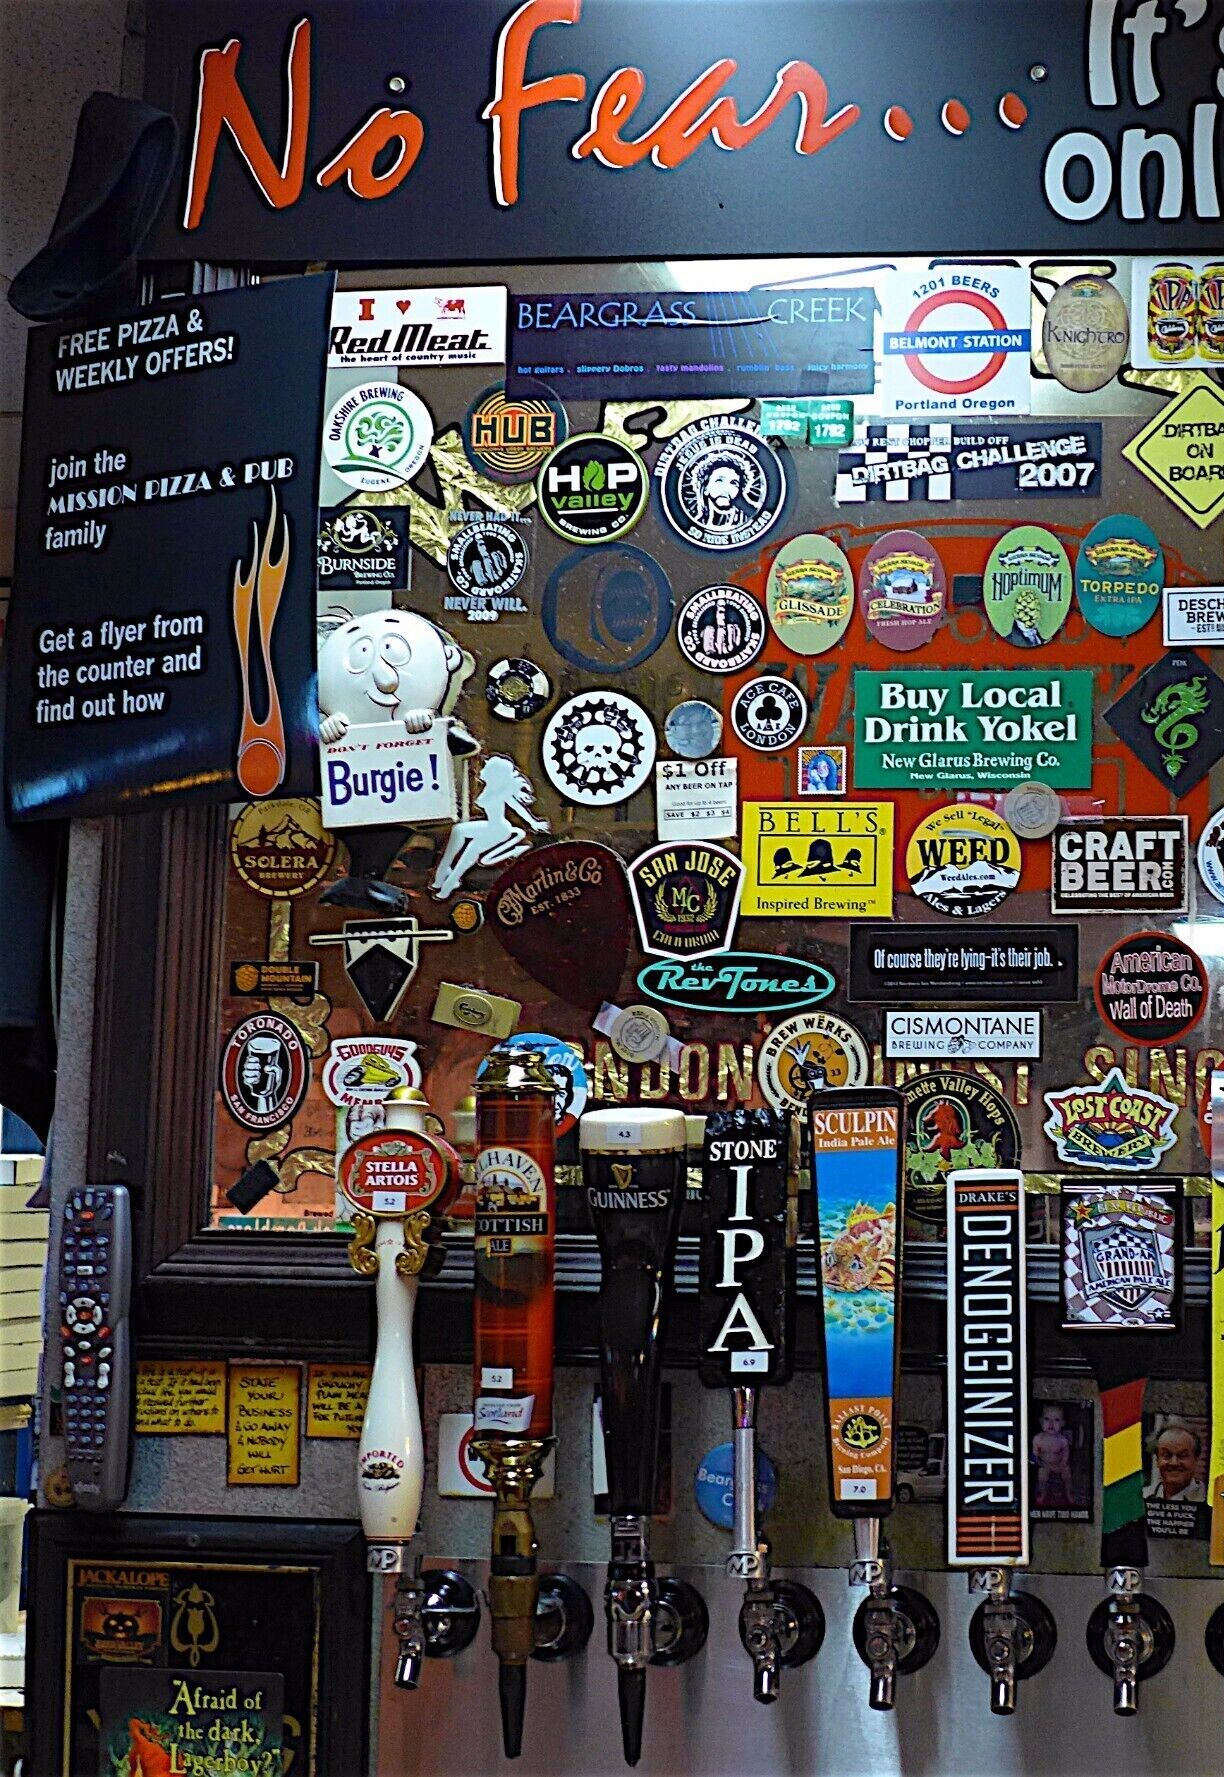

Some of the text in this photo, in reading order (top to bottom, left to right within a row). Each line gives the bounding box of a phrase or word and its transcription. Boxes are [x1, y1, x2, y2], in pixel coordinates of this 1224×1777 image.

[184, 19, 425, 230] No
[912, 275, 1000, 299] 1201 BEERS
[518, 297, 867, 329] BEARGRASS CREEK
[58, 308, 203, 358] FREE PIZZA &
[889, 334, 1022, 350] BELMONT STATION
[56, 336, 234, 392] WEEKLY OFFERS!
[895, 398, 1016, 411] Portland Oregon
[474, 414, 554, 446] HUB
[851, 435, 1087, 486] DIRTBAG CHALLENGE
[1186, 443, 1214, 459] ON
[48, 450, 126, 488] join the
[1018, 462, 1096, 488] 2007
[47, 457, 294, 515] MISSION PIZZA & PUB
[551, 493, 634, 512] valley
[45, 519, 107, 551] family
[1080, 579, 1159, 596] TORPEDO
[778, 599, 845, 618] GLISSADE
[870, 599, 941, 615] CELEBRATION
[39, 614, 203, 653] Get a flyer from
[37, 645, 201, 689] the counter and
[36, 689, 165, 724] find out how
[741, 682, 800, 709] ACE CAFE
[880, 680, 1062, 716] Buy Local
[740, 722, 796, 745] LONDON
[864, 713, 1078, 743] Drink Yokel
[662, 760, 728, 779] $1 Off
[882, 751, 1061, 771] New Glarus Brewing Co.
[328, 754, 440, 805] Burgie!
[665, 781, 733, 791] ANY BEER ON TAP
[910, 771, 1031, 781] New Glarus, Wisconsin
[759, 810, 878, 833] BELL'S
[917, 837, 1010, 867] WEED
[1059, 830, 1180, 860] CRAFT
[244, 855, 319, 869] SOLERA
[638, 850, 737, 888] SAN JOSE
[1060, 861, 1162, 891] BEER
[757, 896, 809, 912] Inspired
[260, 966, 301, 974] DOUBLE
[873, 948, 886, 969] Of
[887, 952, 922, 969] course
[923, 947, 959, 972] they're
[1007, 946, 1032, 968] their
[1110, 946, 1193, 974] American
[260, 975, 313, 984] MOUNTAIN
[1109, 994, 1193, 1020] Wall of Death
[233, 1019, 298, 1050] TORONADO
[890, 1016, 1035, 1036] CISMONTANE
[891, 1040, 1034, 1050] BREWING COMPANY
[229, 1094, 294, 1124] SAN FRANCISCO
[814, 1110, 897, 1135] SCULPIN
[709, 1139, 777, 1161] STONE
[365, 1161, 418, 1173] STELLA
[365, 1174, 419, 1186] ARTOIS
[587, 1189, 669, 1208] GUINNESS
[959, 1190, 1017, 1204] DRAKE'S
[963, 1215, 1014, 1504] DENOGGINIZER
[77, 1569, 170, 1587] JACKALOPE
[244, 1691, 262, 1710] of
[178, 1719, 261, 1746] the dark,
